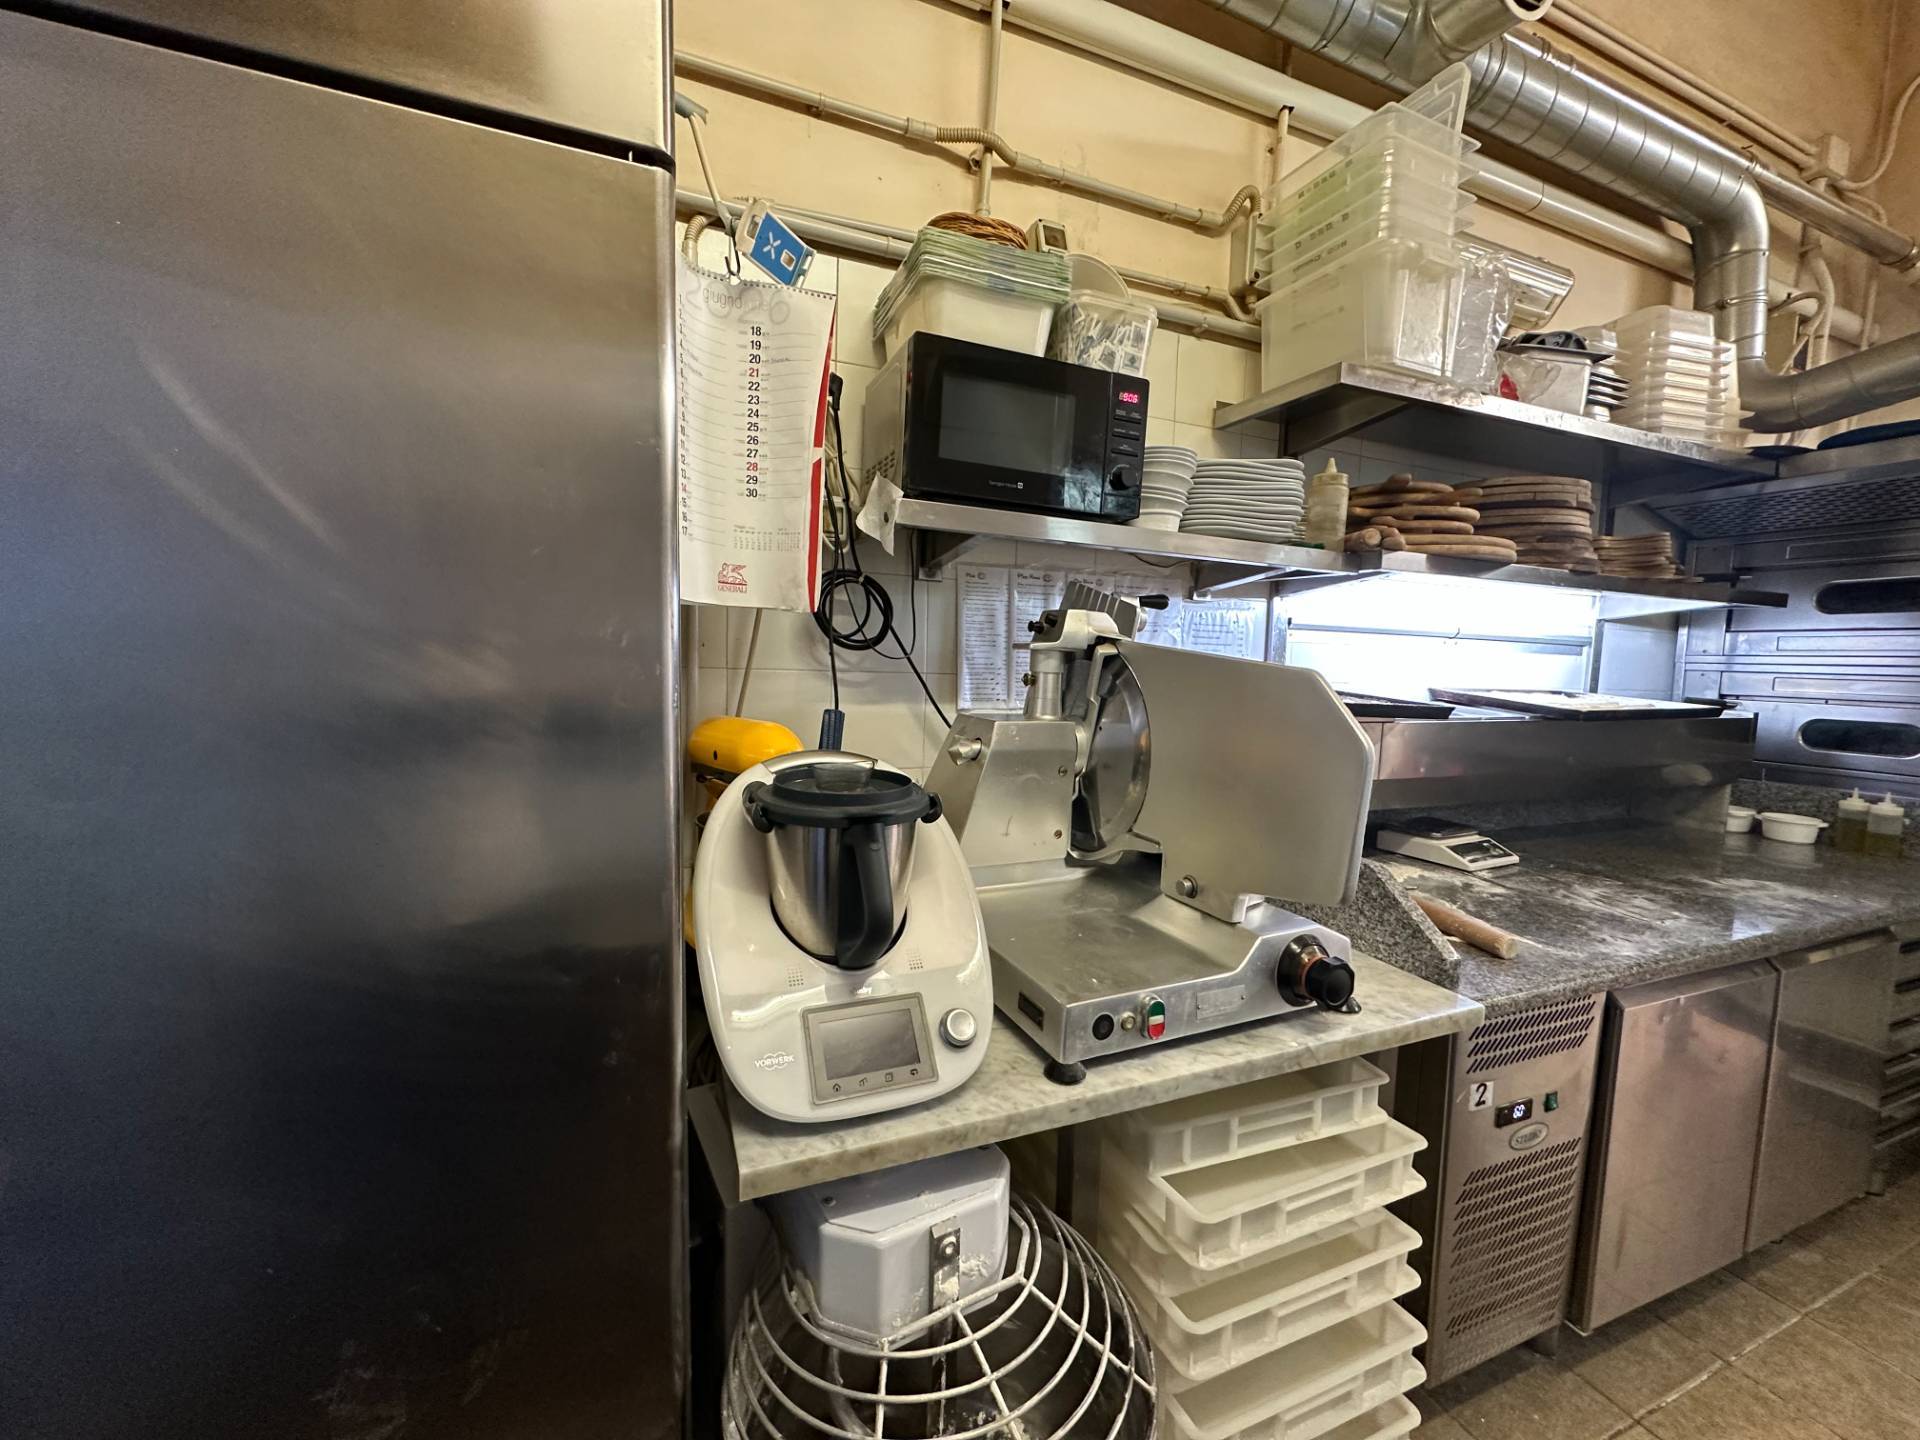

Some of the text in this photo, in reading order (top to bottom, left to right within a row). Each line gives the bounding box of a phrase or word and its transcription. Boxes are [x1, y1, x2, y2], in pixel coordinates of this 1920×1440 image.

[703, 288, 743, 309] giugno
[750, 326, 762, 336] 18
[750, 340, 761, 350] 19
[749, 354, 761, 364] 20
[748, 368, 760, 378] 21
[748, 382, 760, 392] 22
[747, 395, 760, 405] 23
[747, 408, 760, 419] 24
[747, 422, 759, 432] 25
[746, 435, 759, 445] 26
[746, 449, 759, 459] 27
[746, 462, 759, 472] 28
[746, 475, 758, 485] 29
[746, 489, 758, 499] 30
[754, 1055, 794, 1067] VORWERK
[1475, 1083, 1488, 1107] 2
